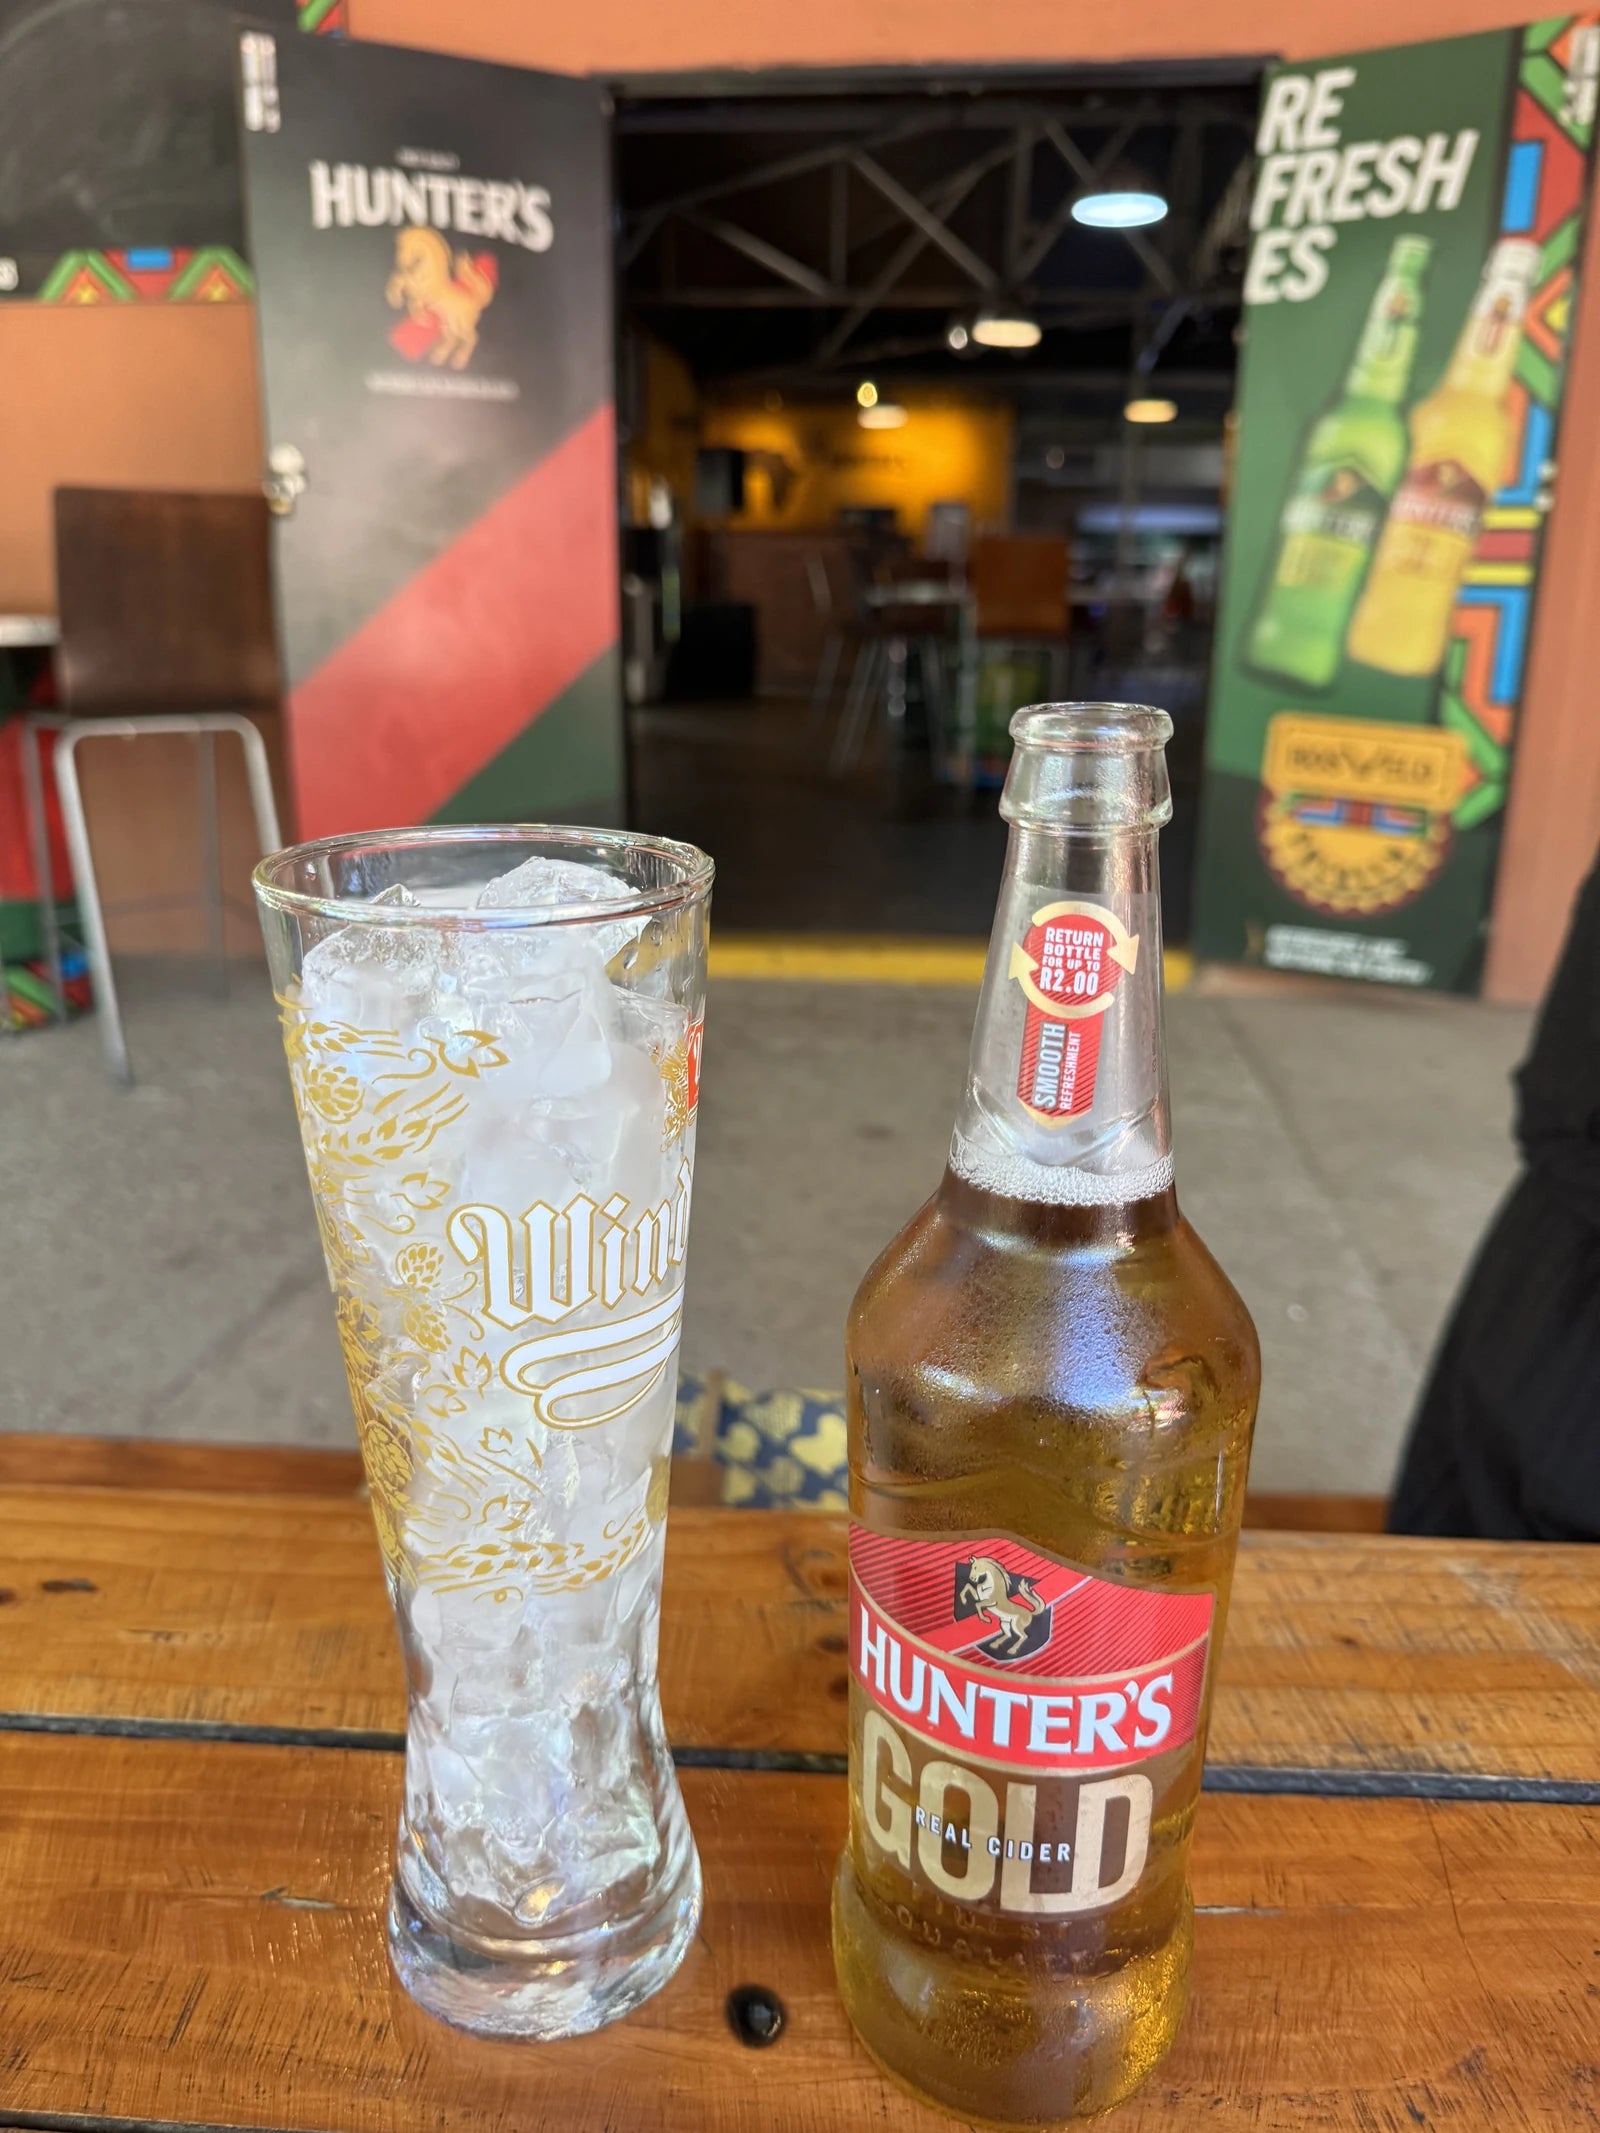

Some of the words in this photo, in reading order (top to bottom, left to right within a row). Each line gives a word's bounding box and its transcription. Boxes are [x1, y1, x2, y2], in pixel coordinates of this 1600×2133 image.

[1256, 66, 1357, 155] RE
[308, 159, 553, 252] HUNTER'S
[1250, 129, 1480, 232] FRESH
[1242, 225, 1338, 306] ES
[1042, 955, 1063, 968] FOR
[1066, 958, 1083, 970] UP
[1086, 960, 1100, 972] TO
[1043, 942, 1102, 961] BOTTLE
[1045, 927, 1104, 947] RETURN
[1039, 967, 1099, 996] R2.00
[1034, 1022, 1067, 1108] SMOOTH
[1059, 1031, 1081, 1110] REFRESHMENT
[859, 1602, 1173, 1755] HUNTER'S
[863, 1708, 1154, 1914] GOLD
[915, 1804, 973, 1850] REAL
[988, 1835, 1072, 1863] CIDER
